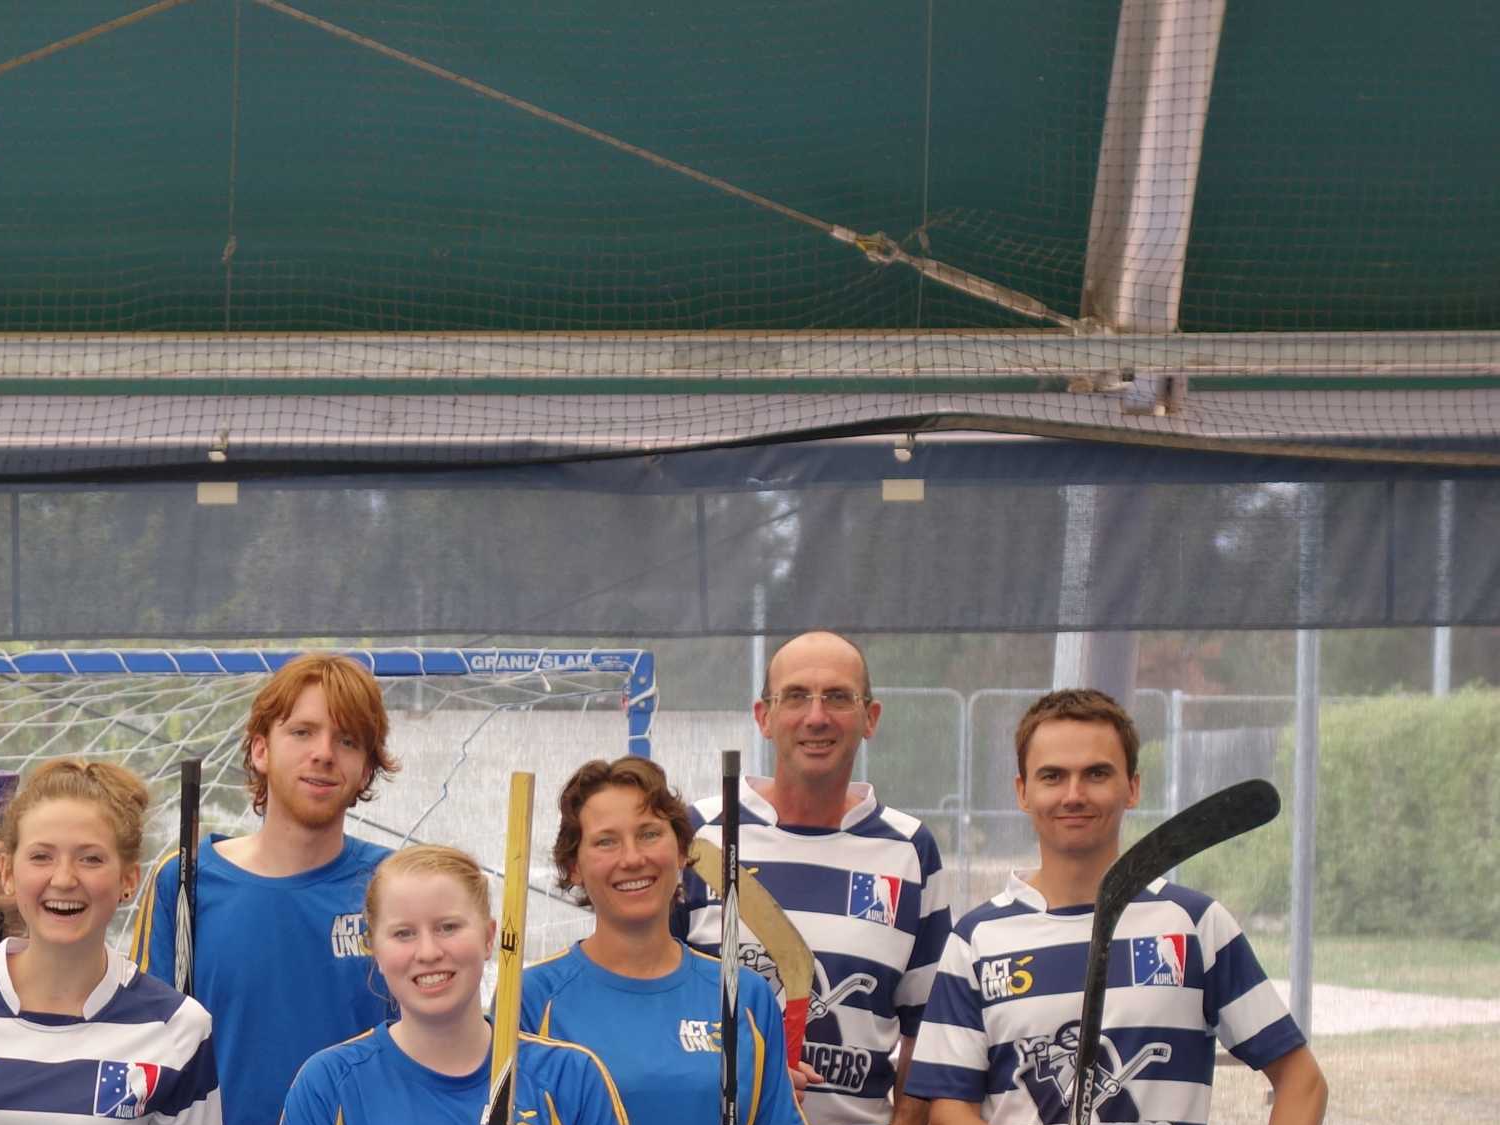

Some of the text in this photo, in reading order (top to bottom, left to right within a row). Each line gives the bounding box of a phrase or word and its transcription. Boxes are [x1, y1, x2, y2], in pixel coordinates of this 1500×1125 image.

[471, 655, 537, 670] GRAND
[543, 655, 592, 669] SLAM
[333, 914, 363, 936] ACT
[982, 958, 1012, 980] ACT
[679, 1019, 708, 1037] ACT
